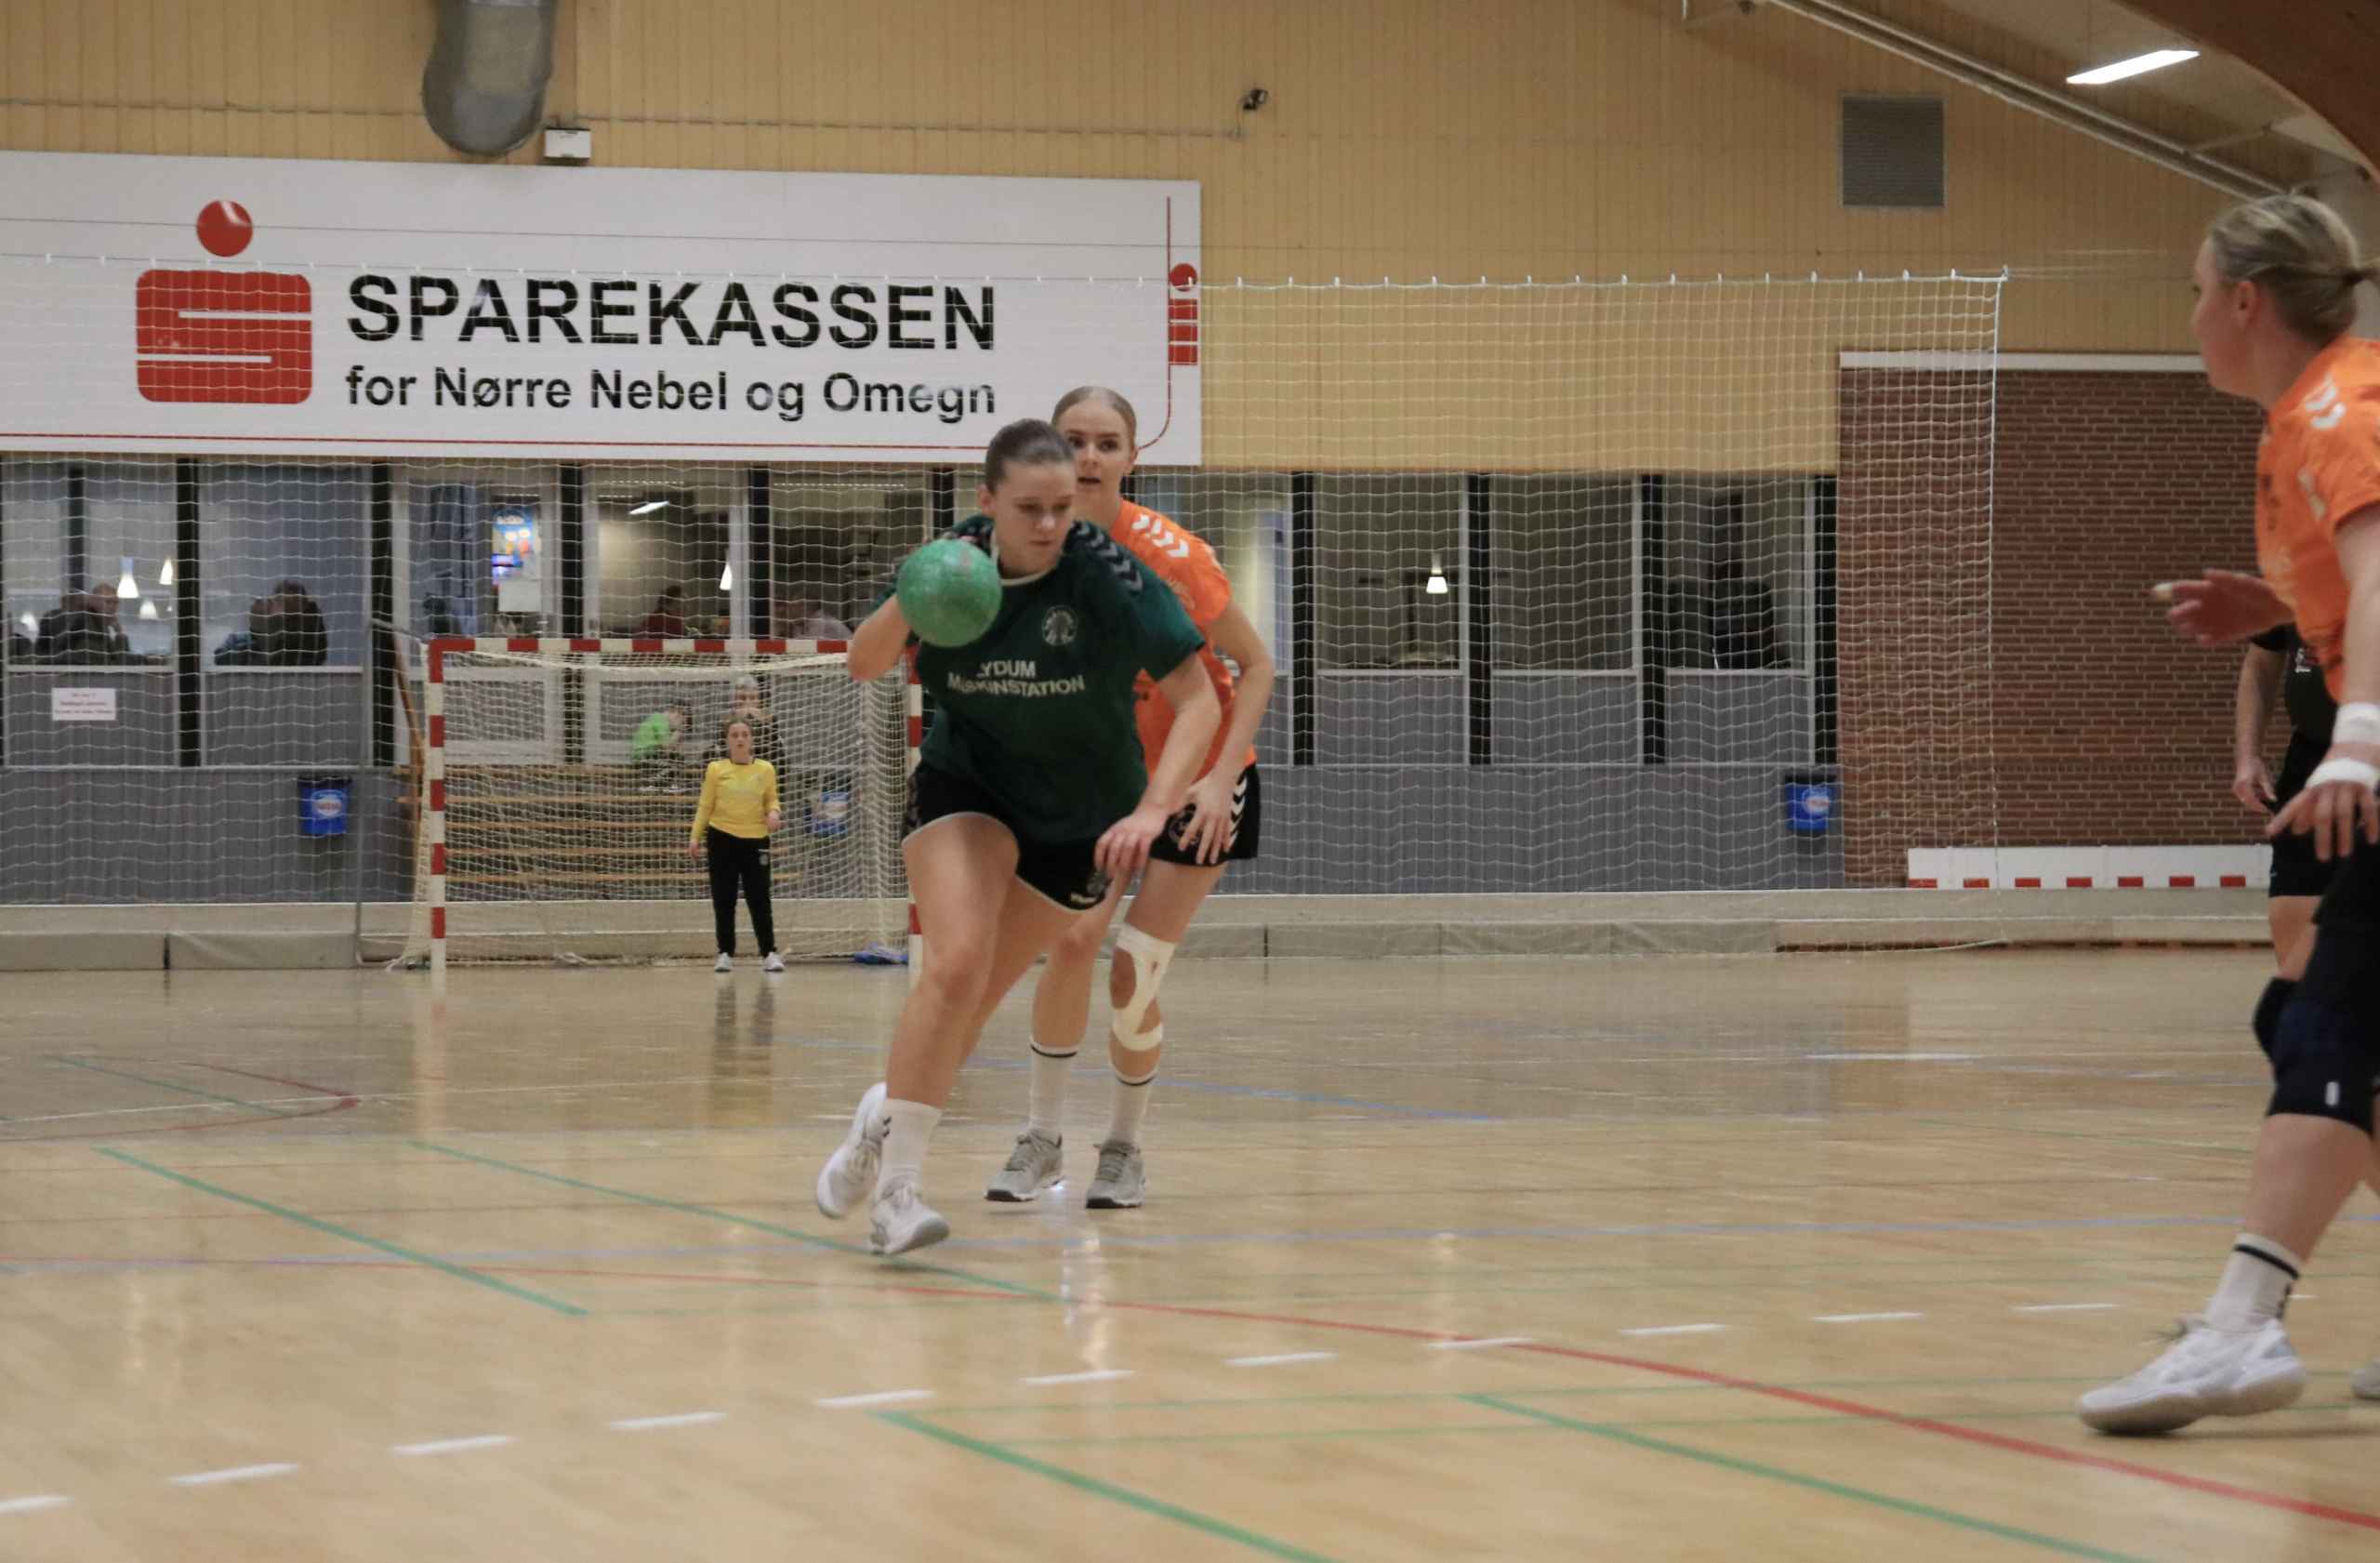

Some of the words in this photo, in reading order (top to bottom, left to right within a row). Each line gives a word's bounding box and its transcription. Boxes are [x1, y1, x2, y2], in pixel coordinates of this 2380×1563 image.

[346, 274, 995, 351] SPAREKASSEN
[345, 365, 417, 406] for
[435, 367, 572, 408] Nørre
[590, 369, 728, 410] Nebel
[746, 381, 805, 422] og
[823, 372, 995, 424] Omegn
